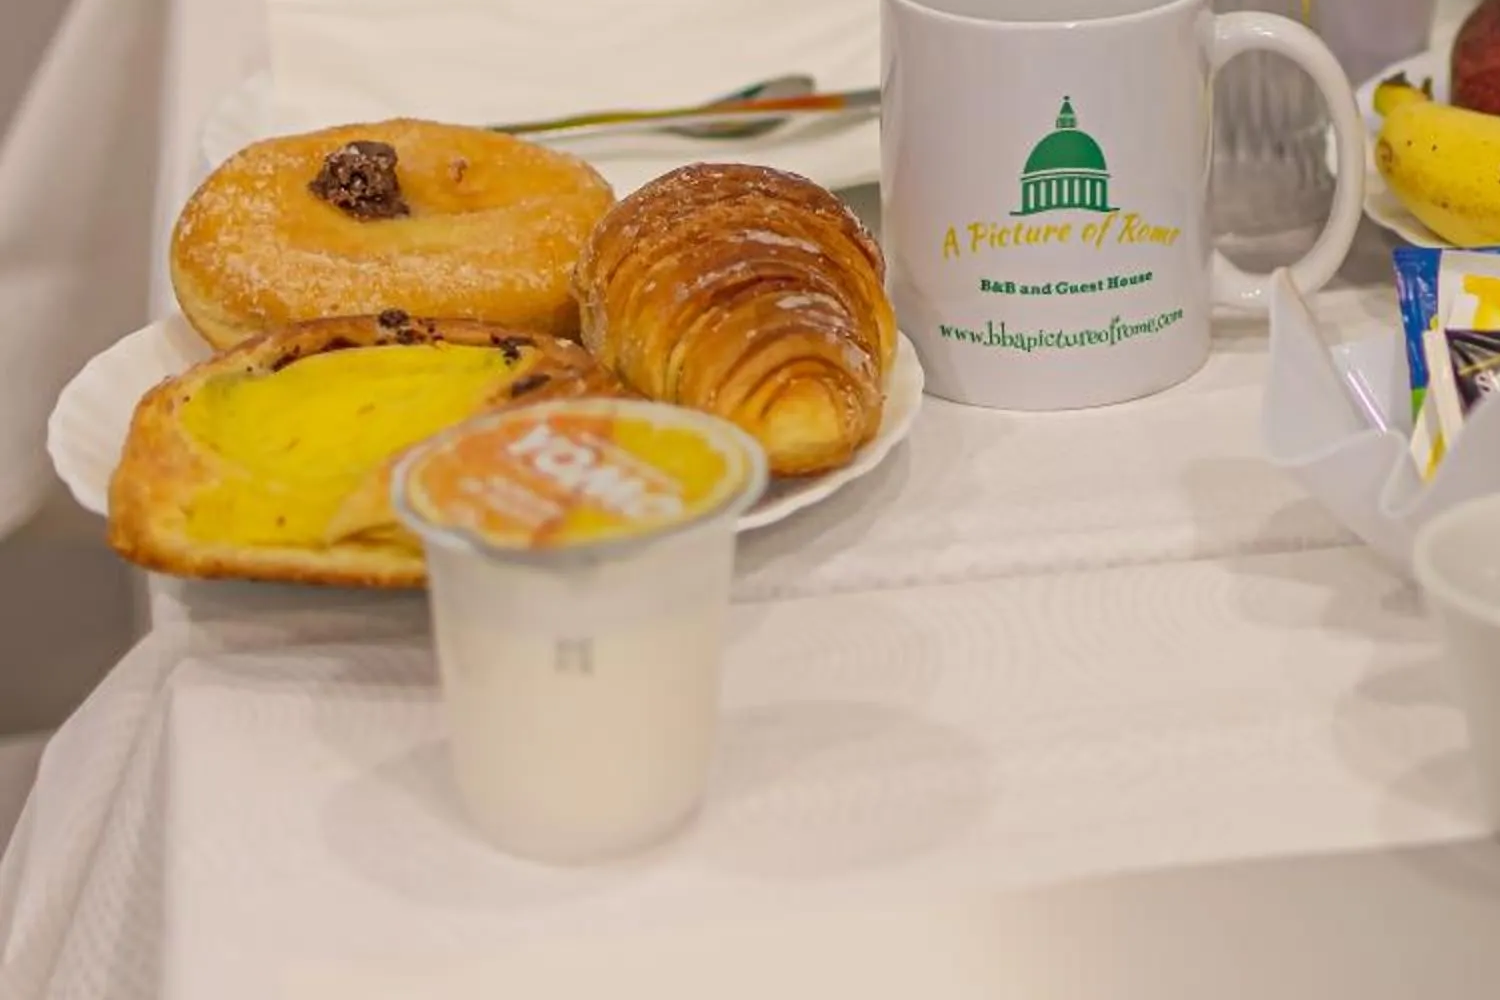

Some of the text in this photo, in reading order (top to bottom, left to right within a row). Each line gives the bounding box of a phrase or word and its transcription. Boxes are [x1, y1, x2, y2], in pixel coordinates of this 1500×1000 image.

[942, 210, 1182, 260] A Picture of Rome
[980, 270, 1153, 296] B&B and Guest House
